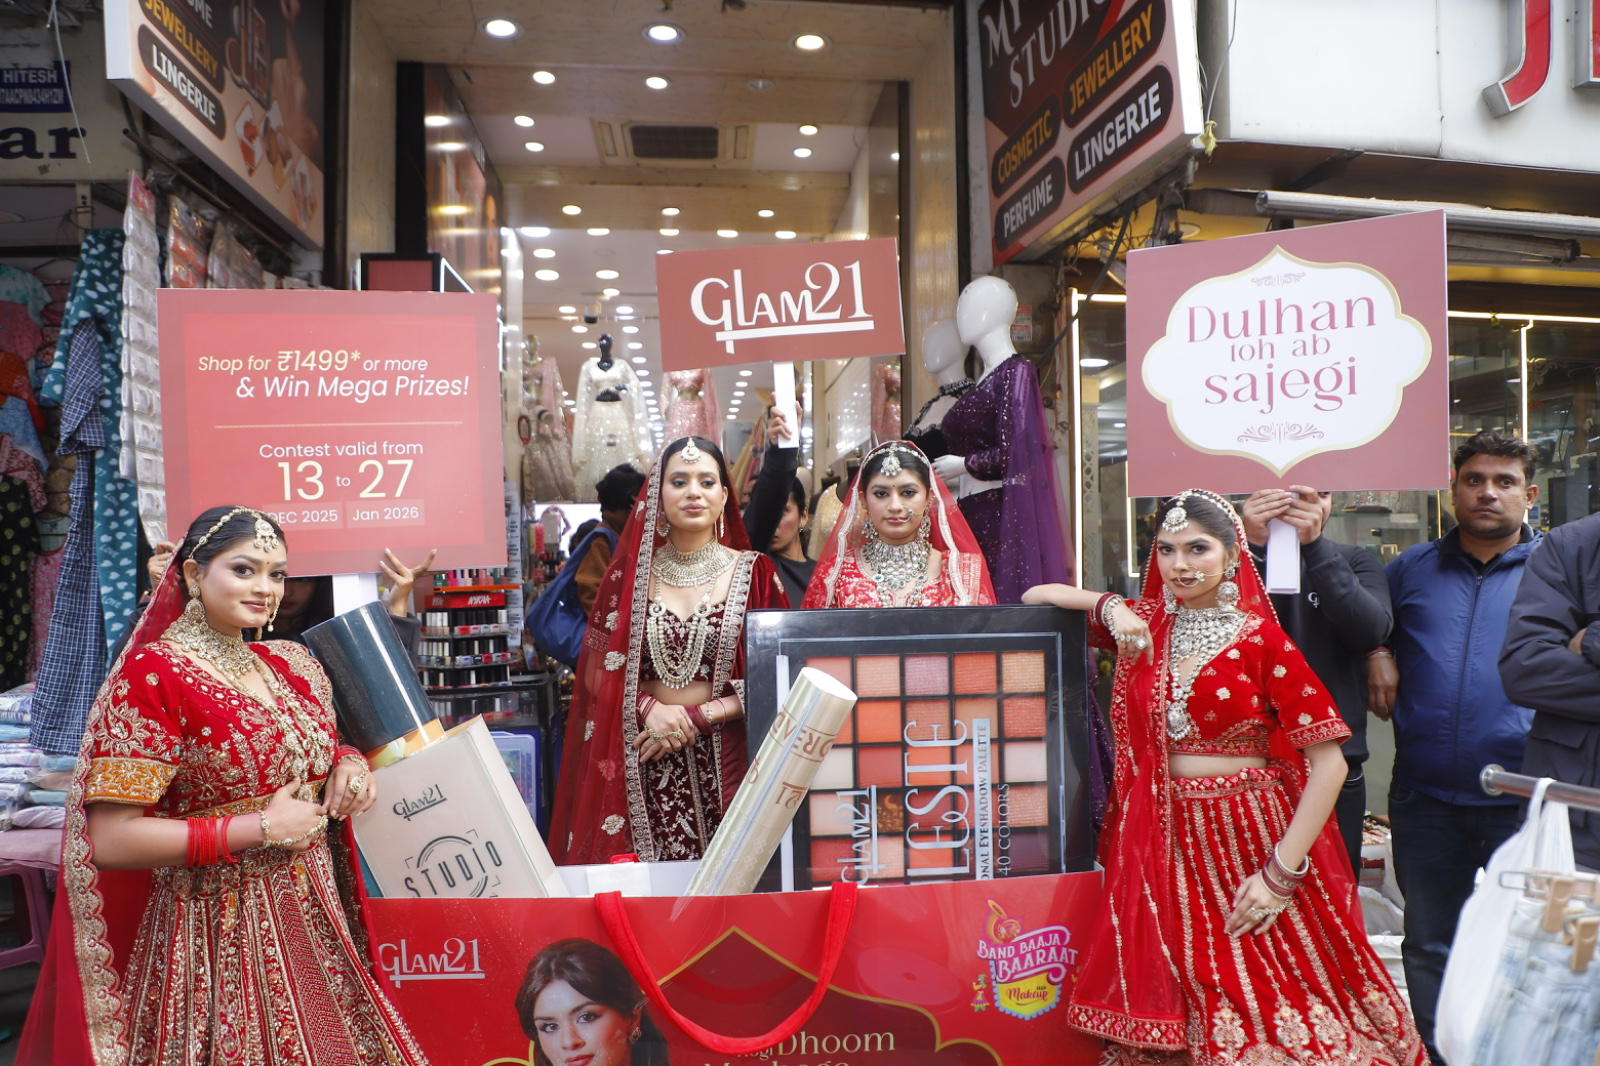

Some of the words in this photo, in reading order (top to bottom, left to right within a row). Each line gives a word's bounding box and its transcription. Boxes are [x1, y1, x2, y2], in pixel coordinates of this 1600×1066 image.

[1010, 0, 1106, 108] STUDI
[1068, 3, 1153, 115] JEWELLERY
[3, 70, 58, 83] HITESH
[152, 43, 216, 125] LINGERIE
[998, 109, 1052, 184] COSMETIC
[1074, 81, 1161, 180] LINGERIE
[1003, 174, 1054, 238] PERFUME
[1187, 296, 1377, 343] Dulhan
[198, 356, 243, 375] Shop
[247, 354, 272, 371] for
[363, 359, 380, 371] or
[384, 358, 429, 371] more
[1230, 338, 1275, 362] toh
[1292, 333, 1331, 357] ab
[236, 376, 255, 398] &
[264, 374, 310, 398] Win
[317, 376, 388, 403] Mega
[395, 374, 470, 397] Prizes!
[1204, 356, 1358, 414] sajegi
[259, 443, 331, 458] Contest
[334, 441, 380, 456] valid
[382, 441, 424, 455] from
[277, 460, 325, 501] 13
[335, 474, 351, 487] to
[358, 459, 414, 499] 27
[302, 509, 338, 523] 2025
[352, 508, 380, 522] Jan
[384, 506, 419, 520] 2026
[976, 726, 987, 773] PALETTE
[978, 777, 990, 848] EYESHADOW
[997, 783, 1011, 850] COLORS
[404, 841, 502, 897] STUDIO
[996, 856, 1012, 876] 40
[977, 939, 1015, 959] BAND
[1020, 933, 1061, 954] BAAJA
[996, 946, 1079, 982] BAARAAT
[1006, 987, 1049, 1001] Makeup
